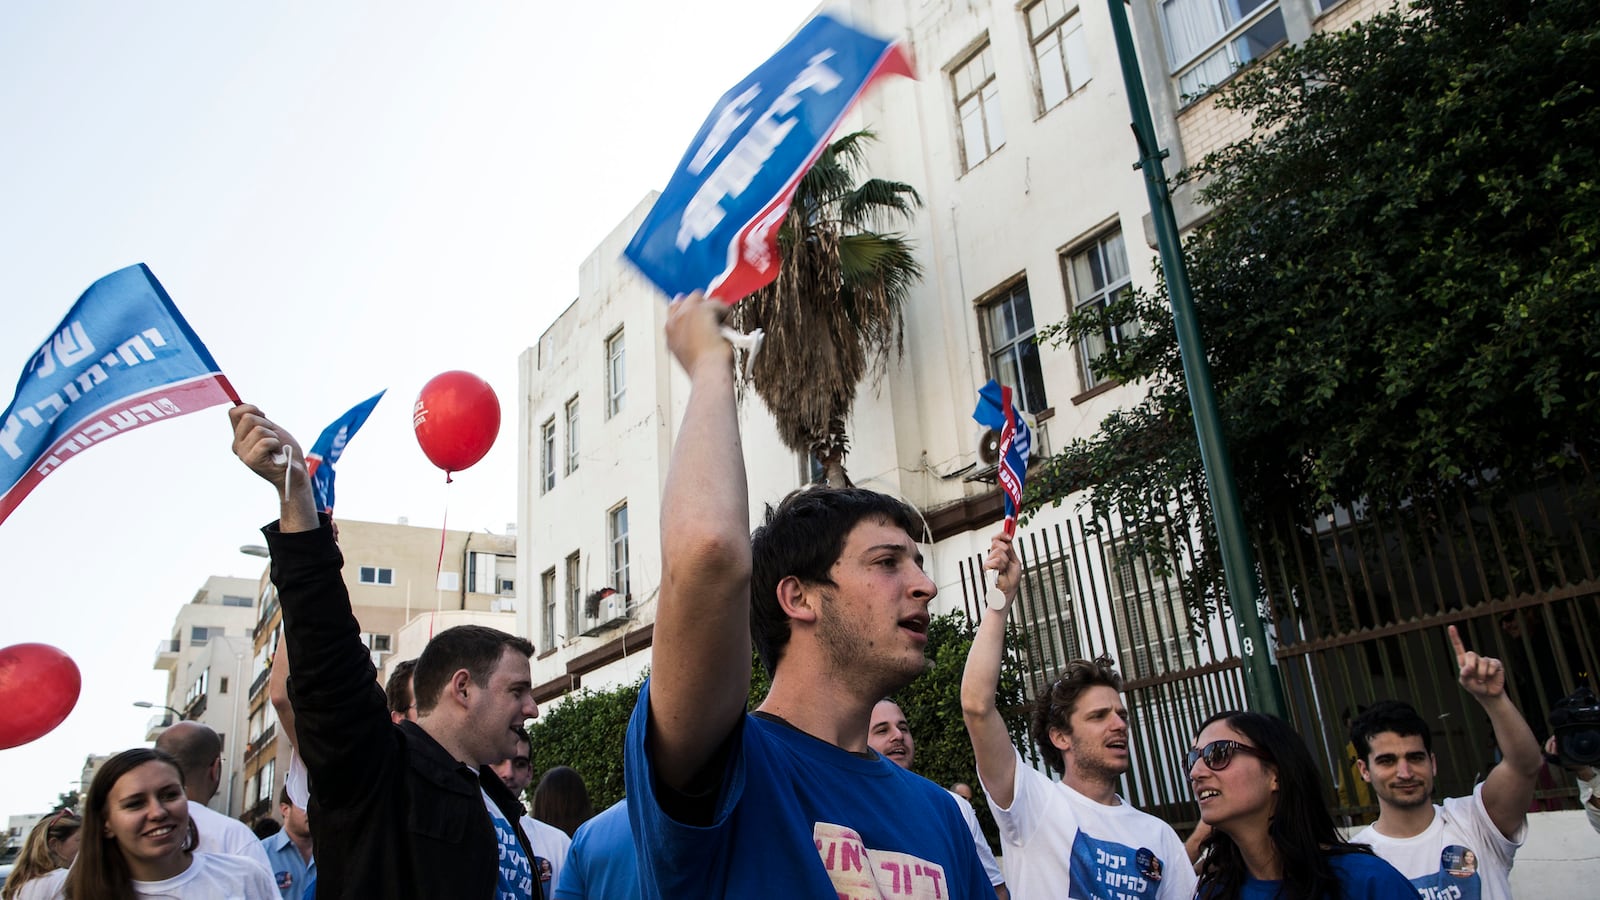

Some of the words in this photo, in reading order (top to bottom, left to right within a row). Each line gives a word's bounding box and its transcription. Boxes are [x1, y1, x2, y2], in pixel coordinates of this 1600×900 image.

[0, 327, 168, 460] יחימוביץ
[37, 399, 163, 476] העבודה
[1096, 848, 1127, 870] יכול
[880, 861, 942, 899] דיור
[1105, 870, 1148, 893] להיות
